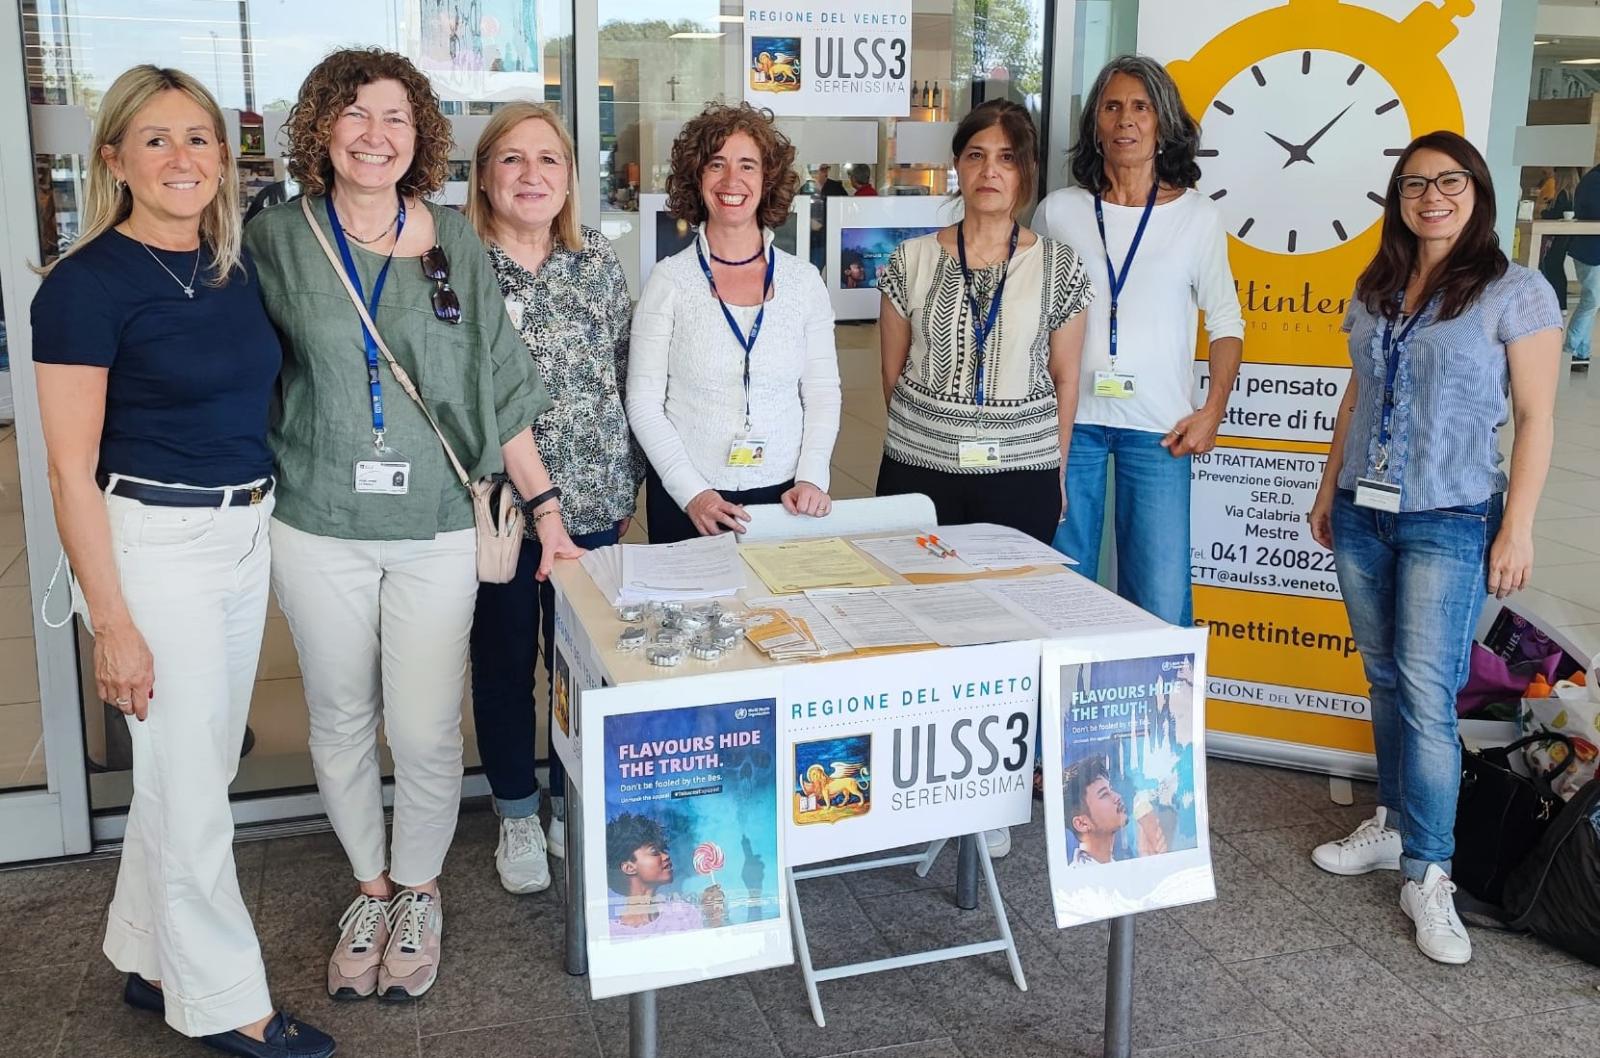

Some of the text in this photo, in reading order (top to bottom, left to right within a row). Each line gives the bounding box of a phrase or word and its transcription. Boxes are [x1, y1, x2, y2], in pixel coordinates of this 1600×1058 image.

[750, 10, 907, 25] REGIONE DEL VENETO
[814, 36, 907, 80] ULSS3
[814, 80, 906, 94] SERENISSIMA
[1247, 376, 1338, 397] pensato
[1287, 410, 1307, 430] di
[1214, 453, 1315, 473] TRATTAMENTO
[1198, 470, 1271, 487] Prevenzione
[1273, 476, 1319, 490] Giovani
[1250, 490, 1295, 506] SER.D.
[1224, 505, 1244, 518] Via
[1246, 507, 1300, 523] Calabria
[1245, 523, 1299, 541] Mestre
[1211, 541, 1248, 564] 041
[1256, 546, 1337, 573] 260822
[791, 692, 889, 720] REGIONE
[902, 687, 940, 706] DEL
[952, 675, 1032, 700] VENETO
[1071, 684, 1146, 706] FLAVOURS
[1269, 693, 1290, 705] DEL
[1294, 692, 1366, 714] VENETO
[1071, 700, 1152, 722] THE TRUTH.
[618, 729, 761, 761] FLAVOURS HIDE
[892, 711, 1030, 790] ULSS3
[619, 753, 724, 779] THE TRUTH.
[643, 782, 654, 790] be
[655, 778, 680, 788] fooled
[682, 777, 692, 786] by
[693, 775, 706, 784] the
[891, 773, 1026, 812] SERENISSIMA
